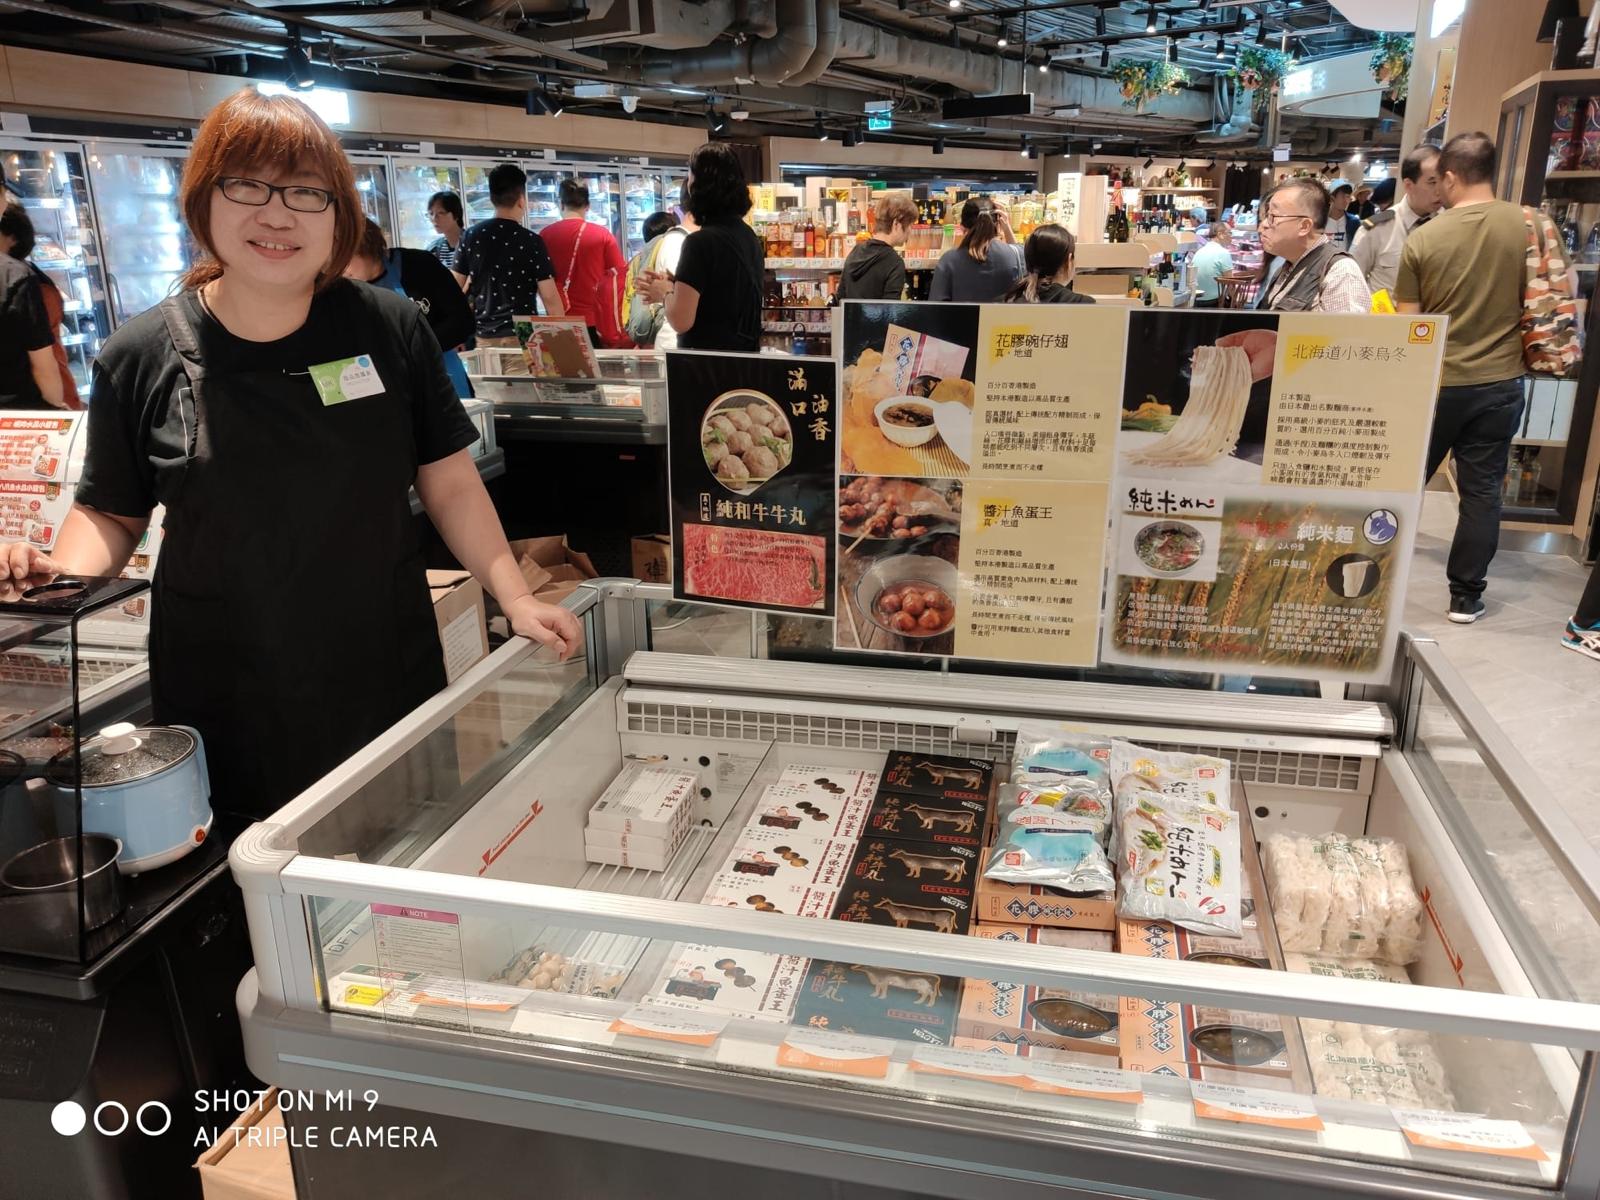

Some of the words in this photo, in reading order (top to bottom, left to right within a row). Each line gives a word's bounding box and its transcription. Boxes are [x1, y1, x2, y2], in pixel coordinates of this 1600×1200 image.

[996, 334, 1069, 348] 花膠碗仔翅
[1292, 343, 1407, 362] 北海道小麥烏冬
[1280, 393, 1311, 402] 日本製造
[808, 394, 832, 441] 油香
[1128, 487, 1214, 514] 純米めん
[716, 499, 807, 526] 純和牛牛丸
[984, 504, 1052, 519] 醬汁魚蛋王
[1296, 521, 1355, 544] 純米麵
[409, 910, 428, 919] NOTE
